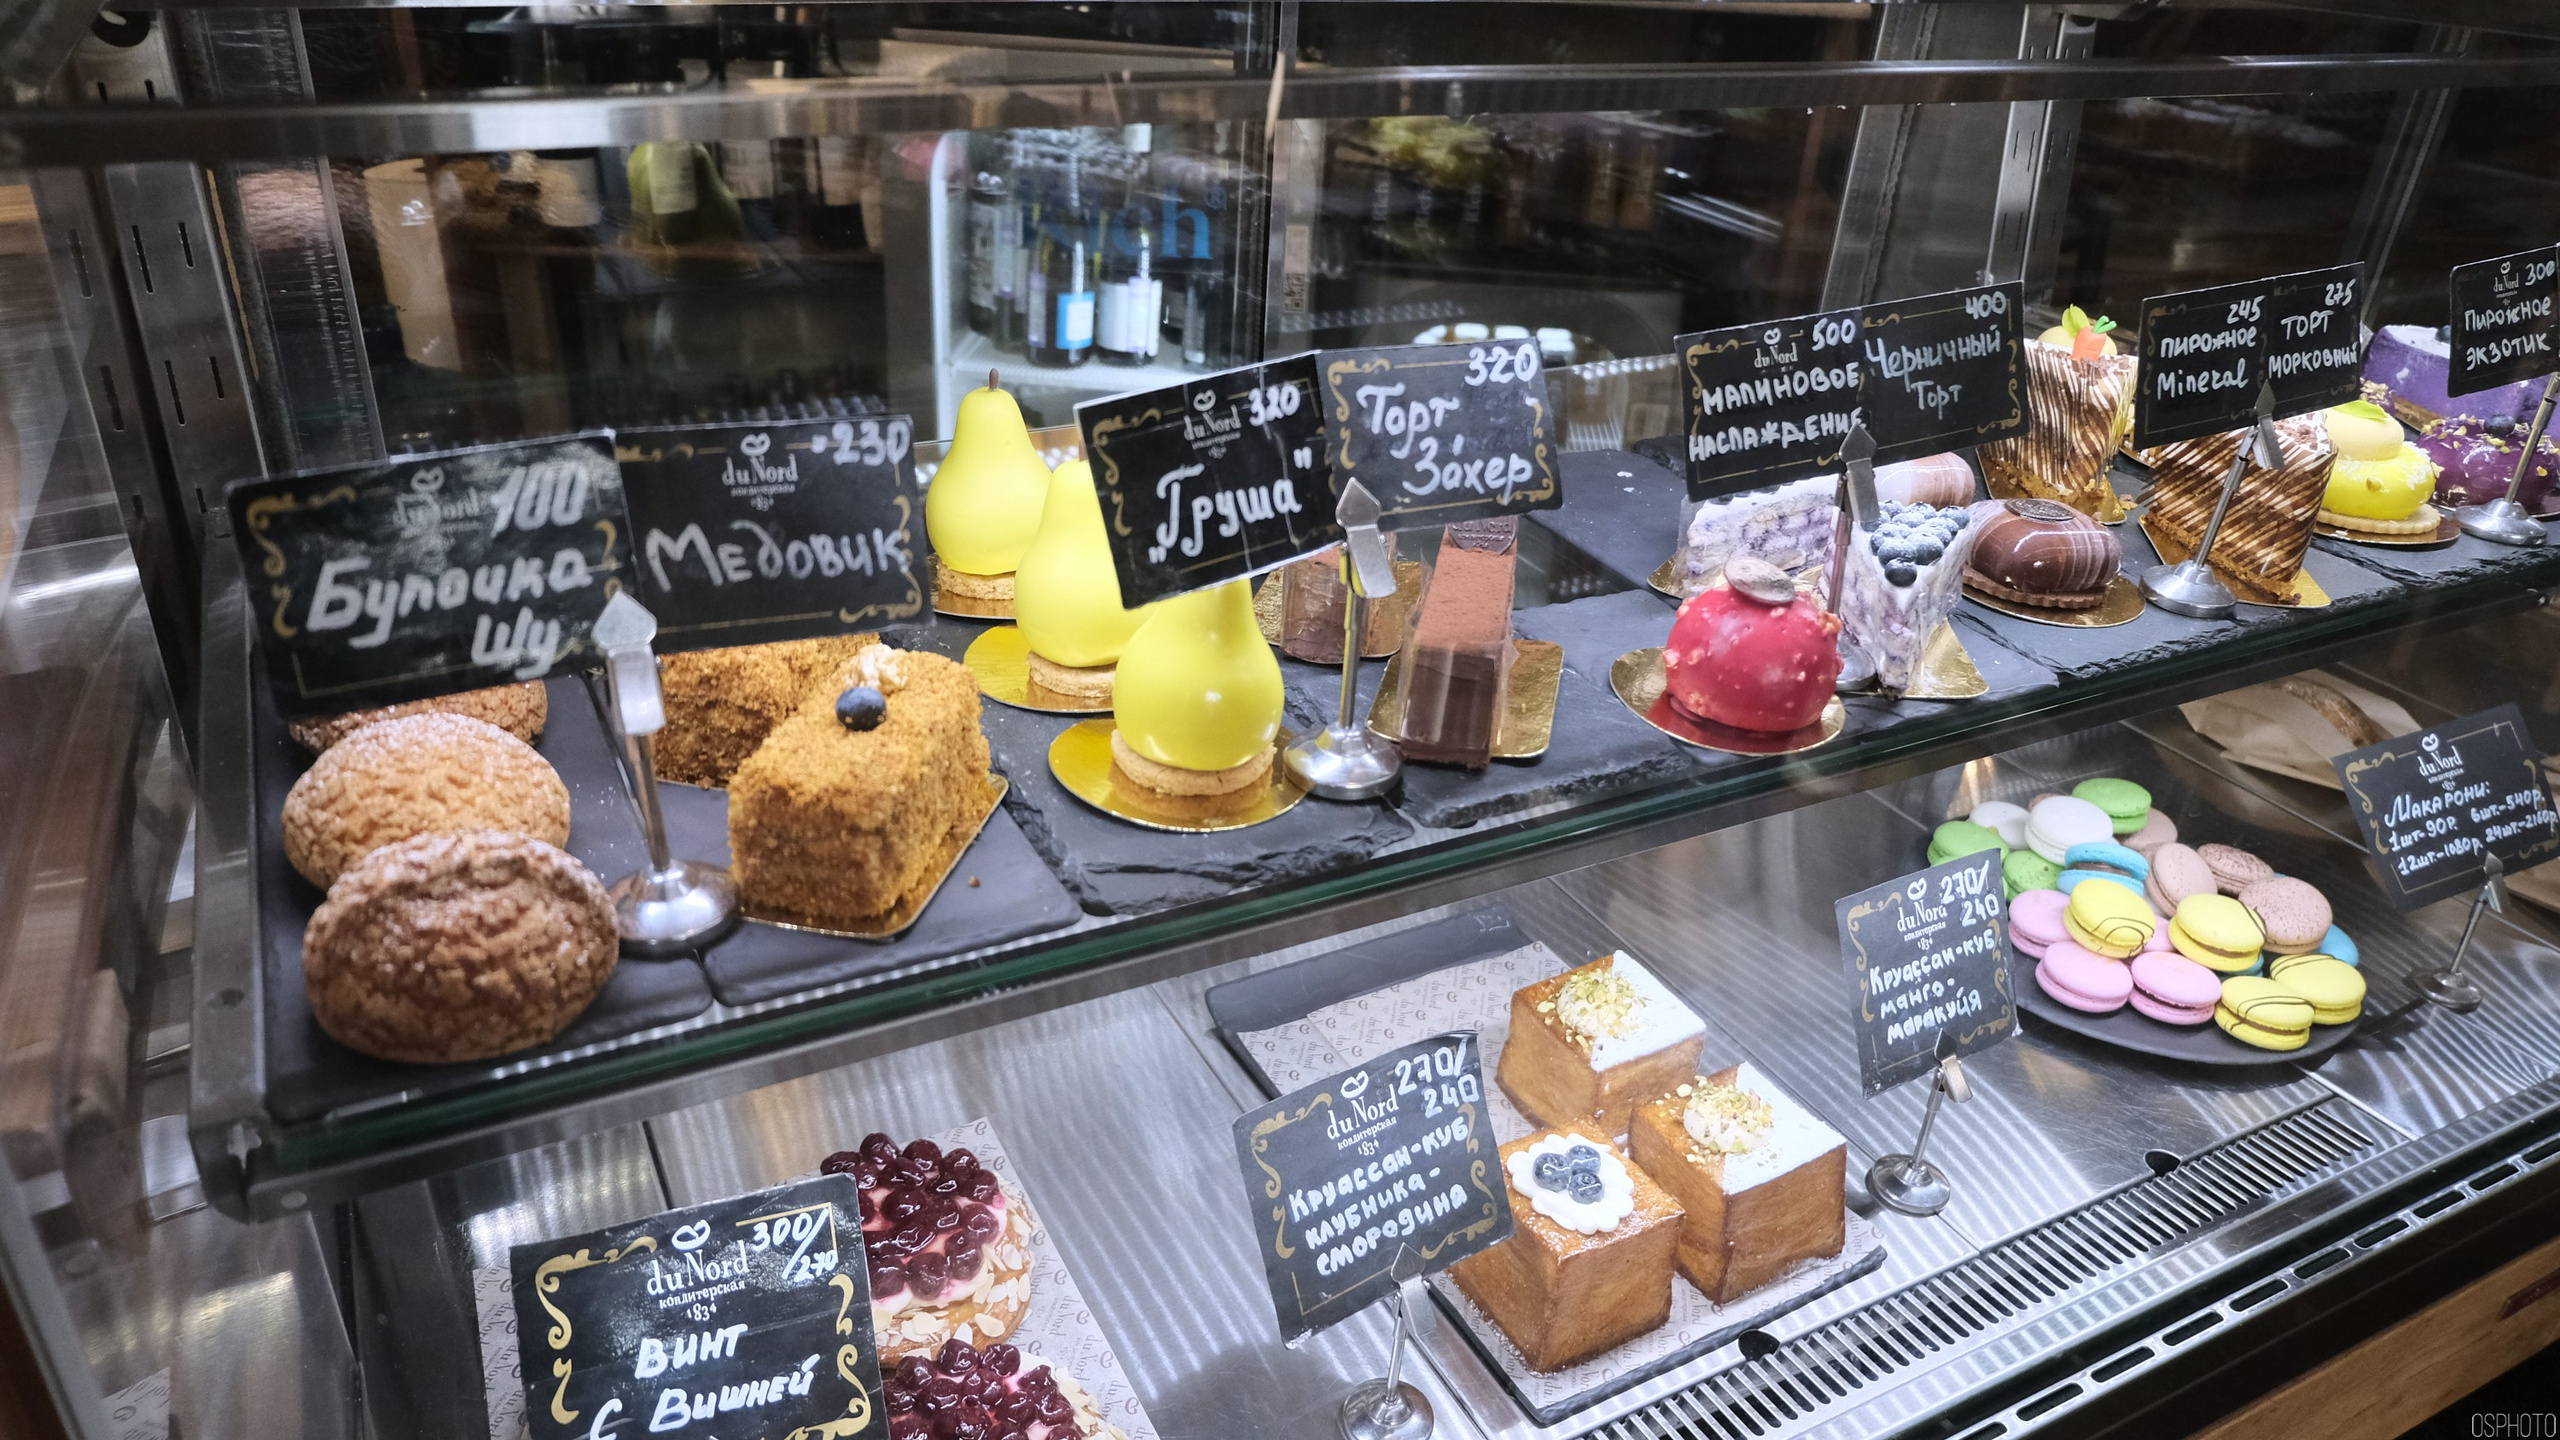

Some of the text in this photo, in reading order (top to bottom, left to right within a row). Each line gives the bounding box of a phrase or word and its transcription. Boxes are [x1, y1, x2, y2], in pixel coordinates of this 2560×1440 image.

[1965, 291, 2007, 320] 400
[2226, 295, 2266, 325] 245
[2324, 278, 2357, 307] 275
[1811, 318, 1856, 352] 500
[2466, 332, 2552, 371] ЭКЗОТИК
[1463, 342, 1539, 387] 320
[1864, 324, 2001, 393] Черничный
[2157, 358, 2250, 400] Mineral
[1248, 382, 1301, 427] 320
[1355, 383, 1460, 460] Торт
[1910, 380, 1963, 421] Торт
[490, 462, 590, 538] 100
[1961, 893, 2000, 927] 240
[1327, 1083, 1400, 1140] du Nord
[1421, 1073, 1479, 1119] 240
[646, 1240, 750, 1296] du Nord
